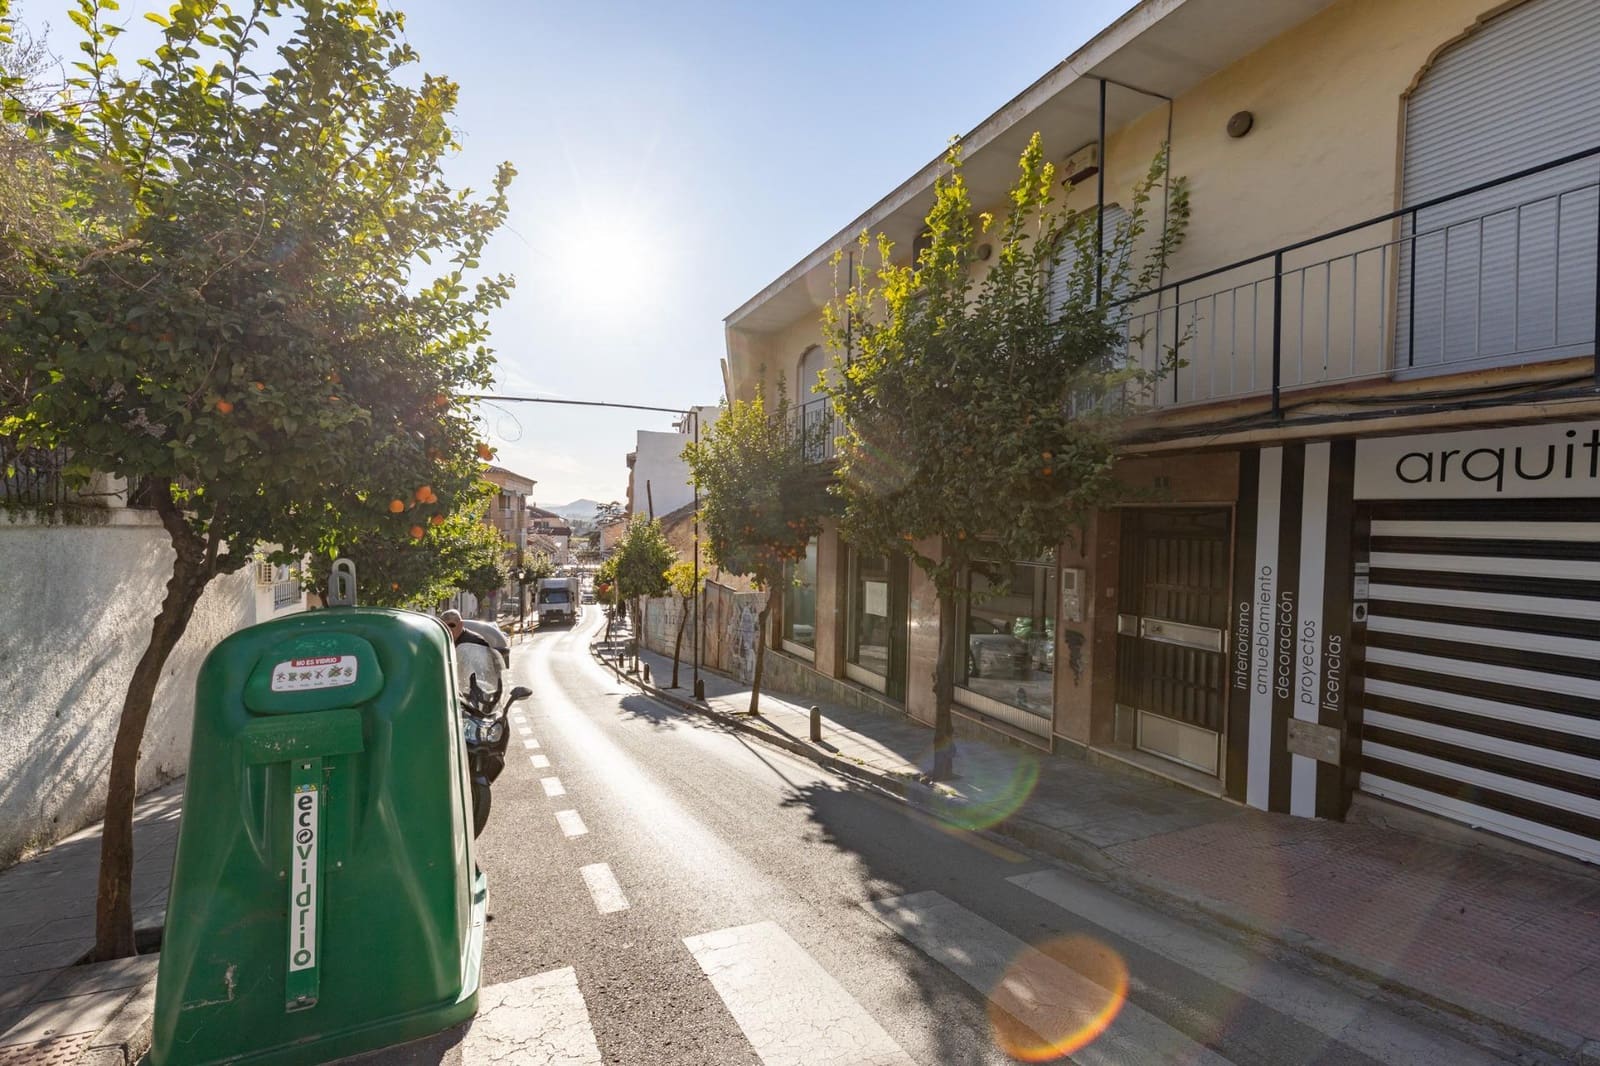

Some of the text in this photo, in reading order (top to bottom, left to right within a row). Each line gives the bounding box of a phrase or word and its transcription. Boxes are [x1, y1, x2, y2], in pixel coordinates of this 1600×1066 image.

[1233, 601, 1250, 690] interiorismo
[1255, 565, 1272, 695] amueblamiento
[1300, 619, 1316, 705] proyectos
[1322, 634, 1341, 712] licencias
[294, 794, 314, 966] ecovidrio
